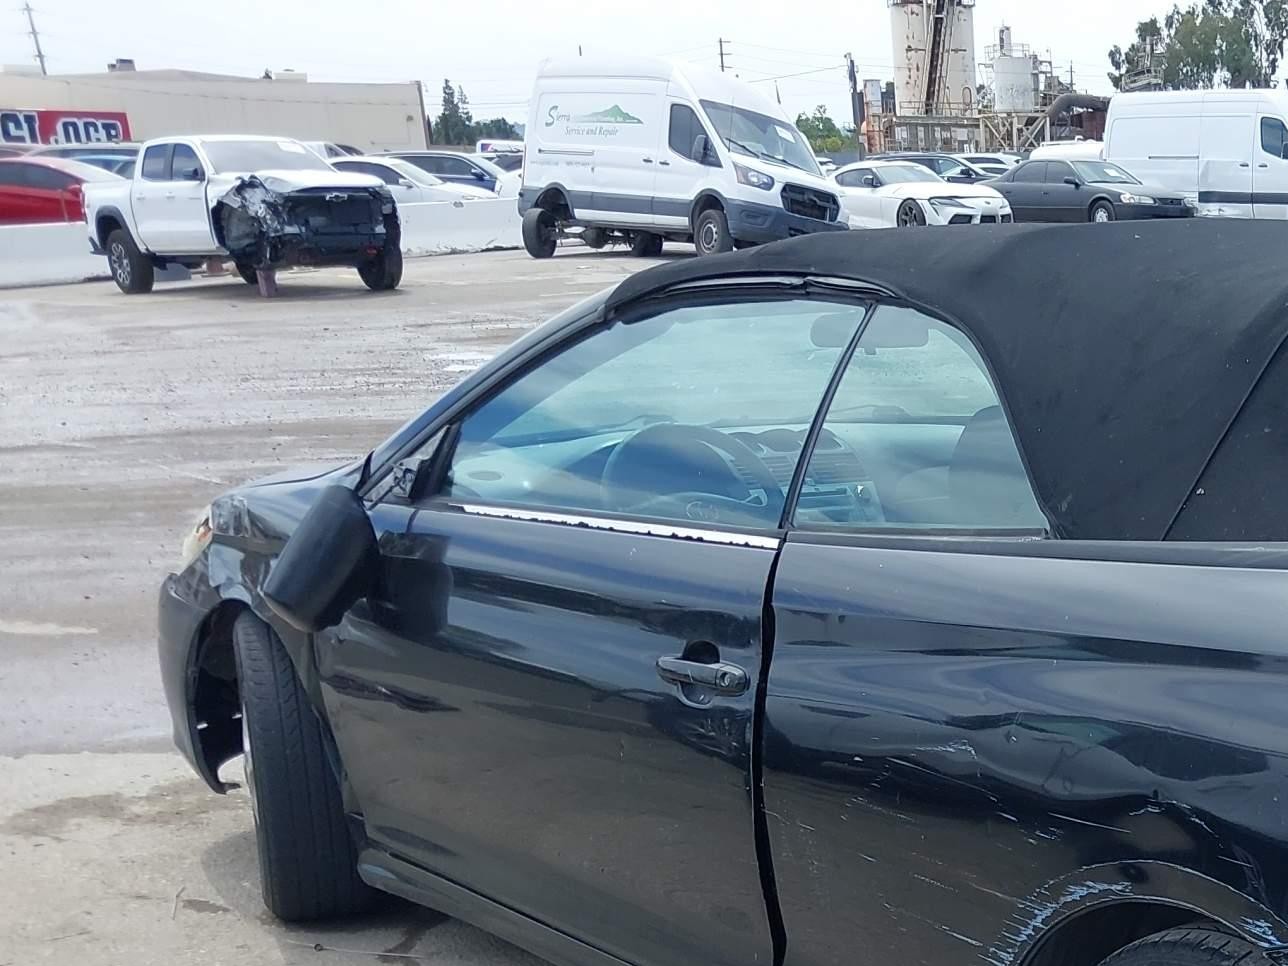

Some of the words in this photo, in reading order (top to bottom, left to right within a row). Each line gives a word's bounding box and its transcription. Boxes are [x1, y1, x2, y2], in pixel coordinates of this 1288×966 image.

[545, 105, 571, 127] Sierra
[564, 127, 584, 136] Service
[586, 127, 598, 136] and
[598, 127, 619, 138] Repair
